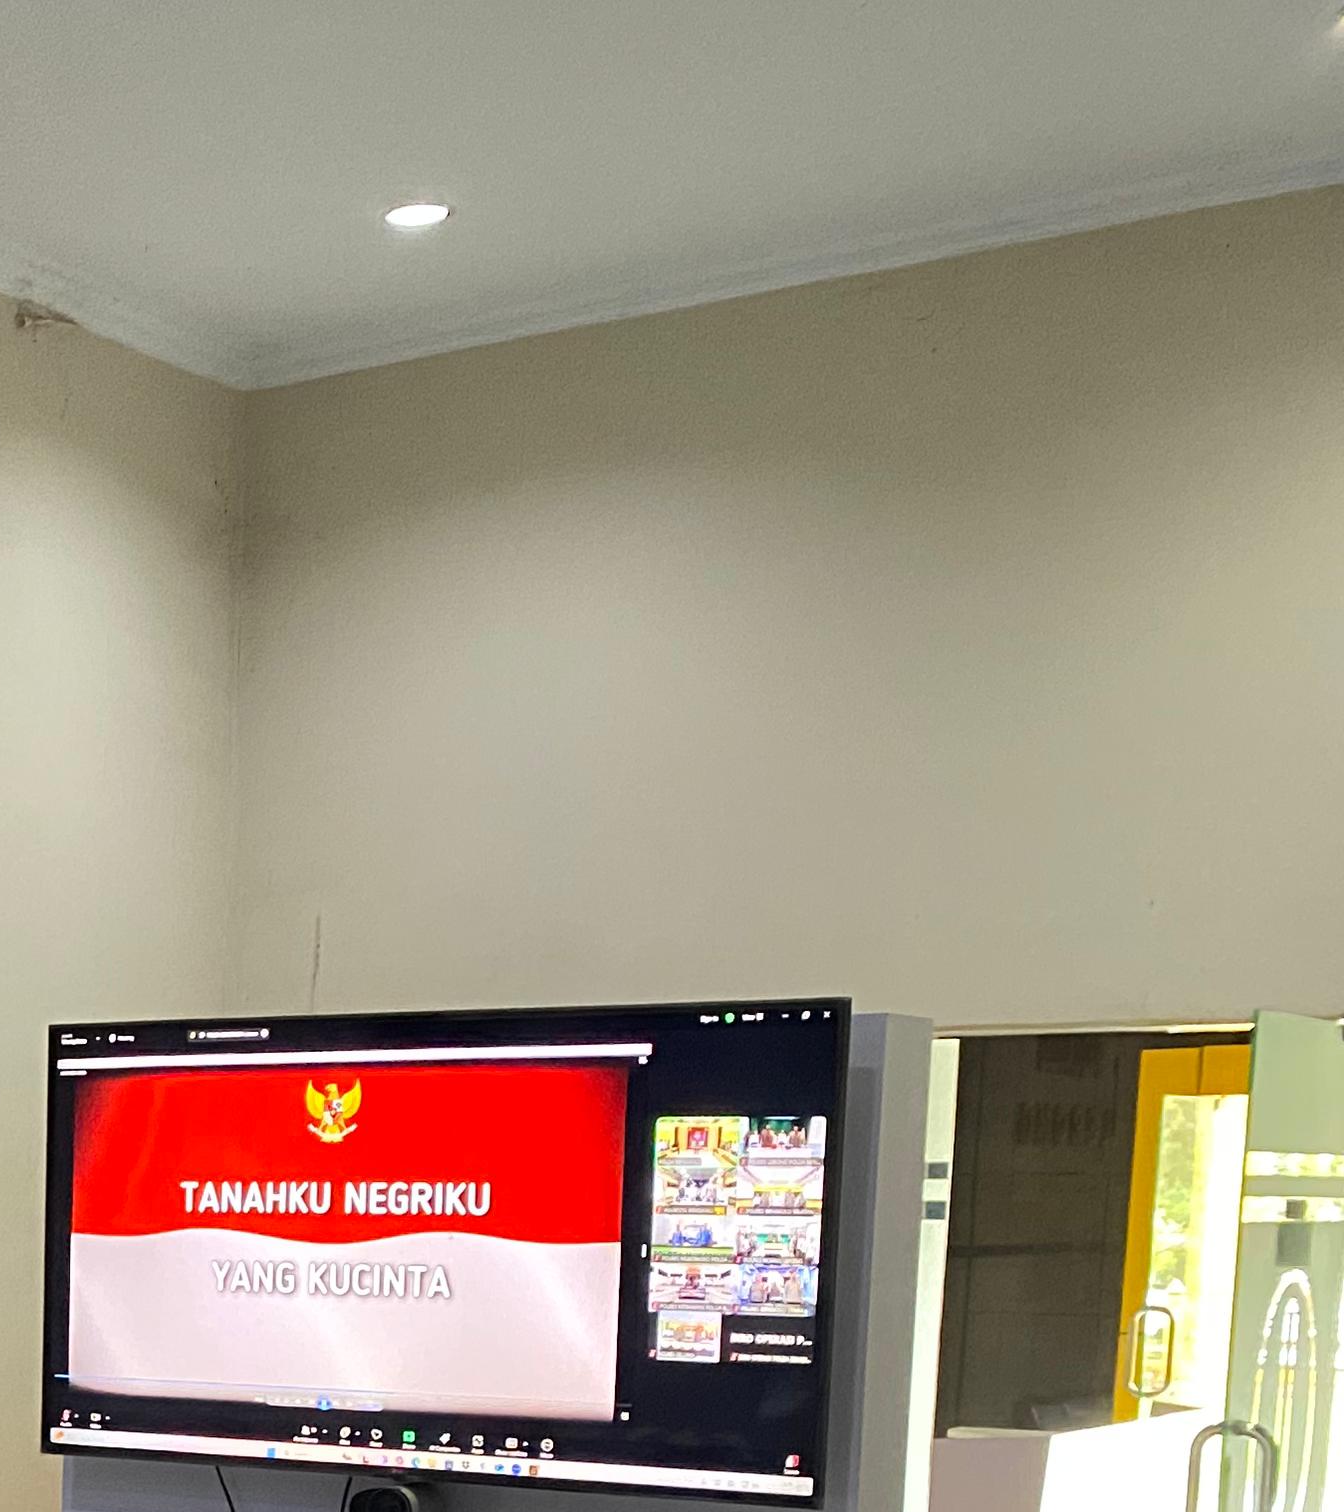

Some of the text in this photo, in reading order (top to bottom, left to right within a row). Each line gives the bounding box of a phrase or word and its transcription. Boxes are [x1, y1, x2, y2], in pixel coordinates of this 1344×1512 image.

[179, 1180, 492, 1217] TANAHKU NEGRIKU
[211, 1260, 452, 1299] YANG KUCINTA
